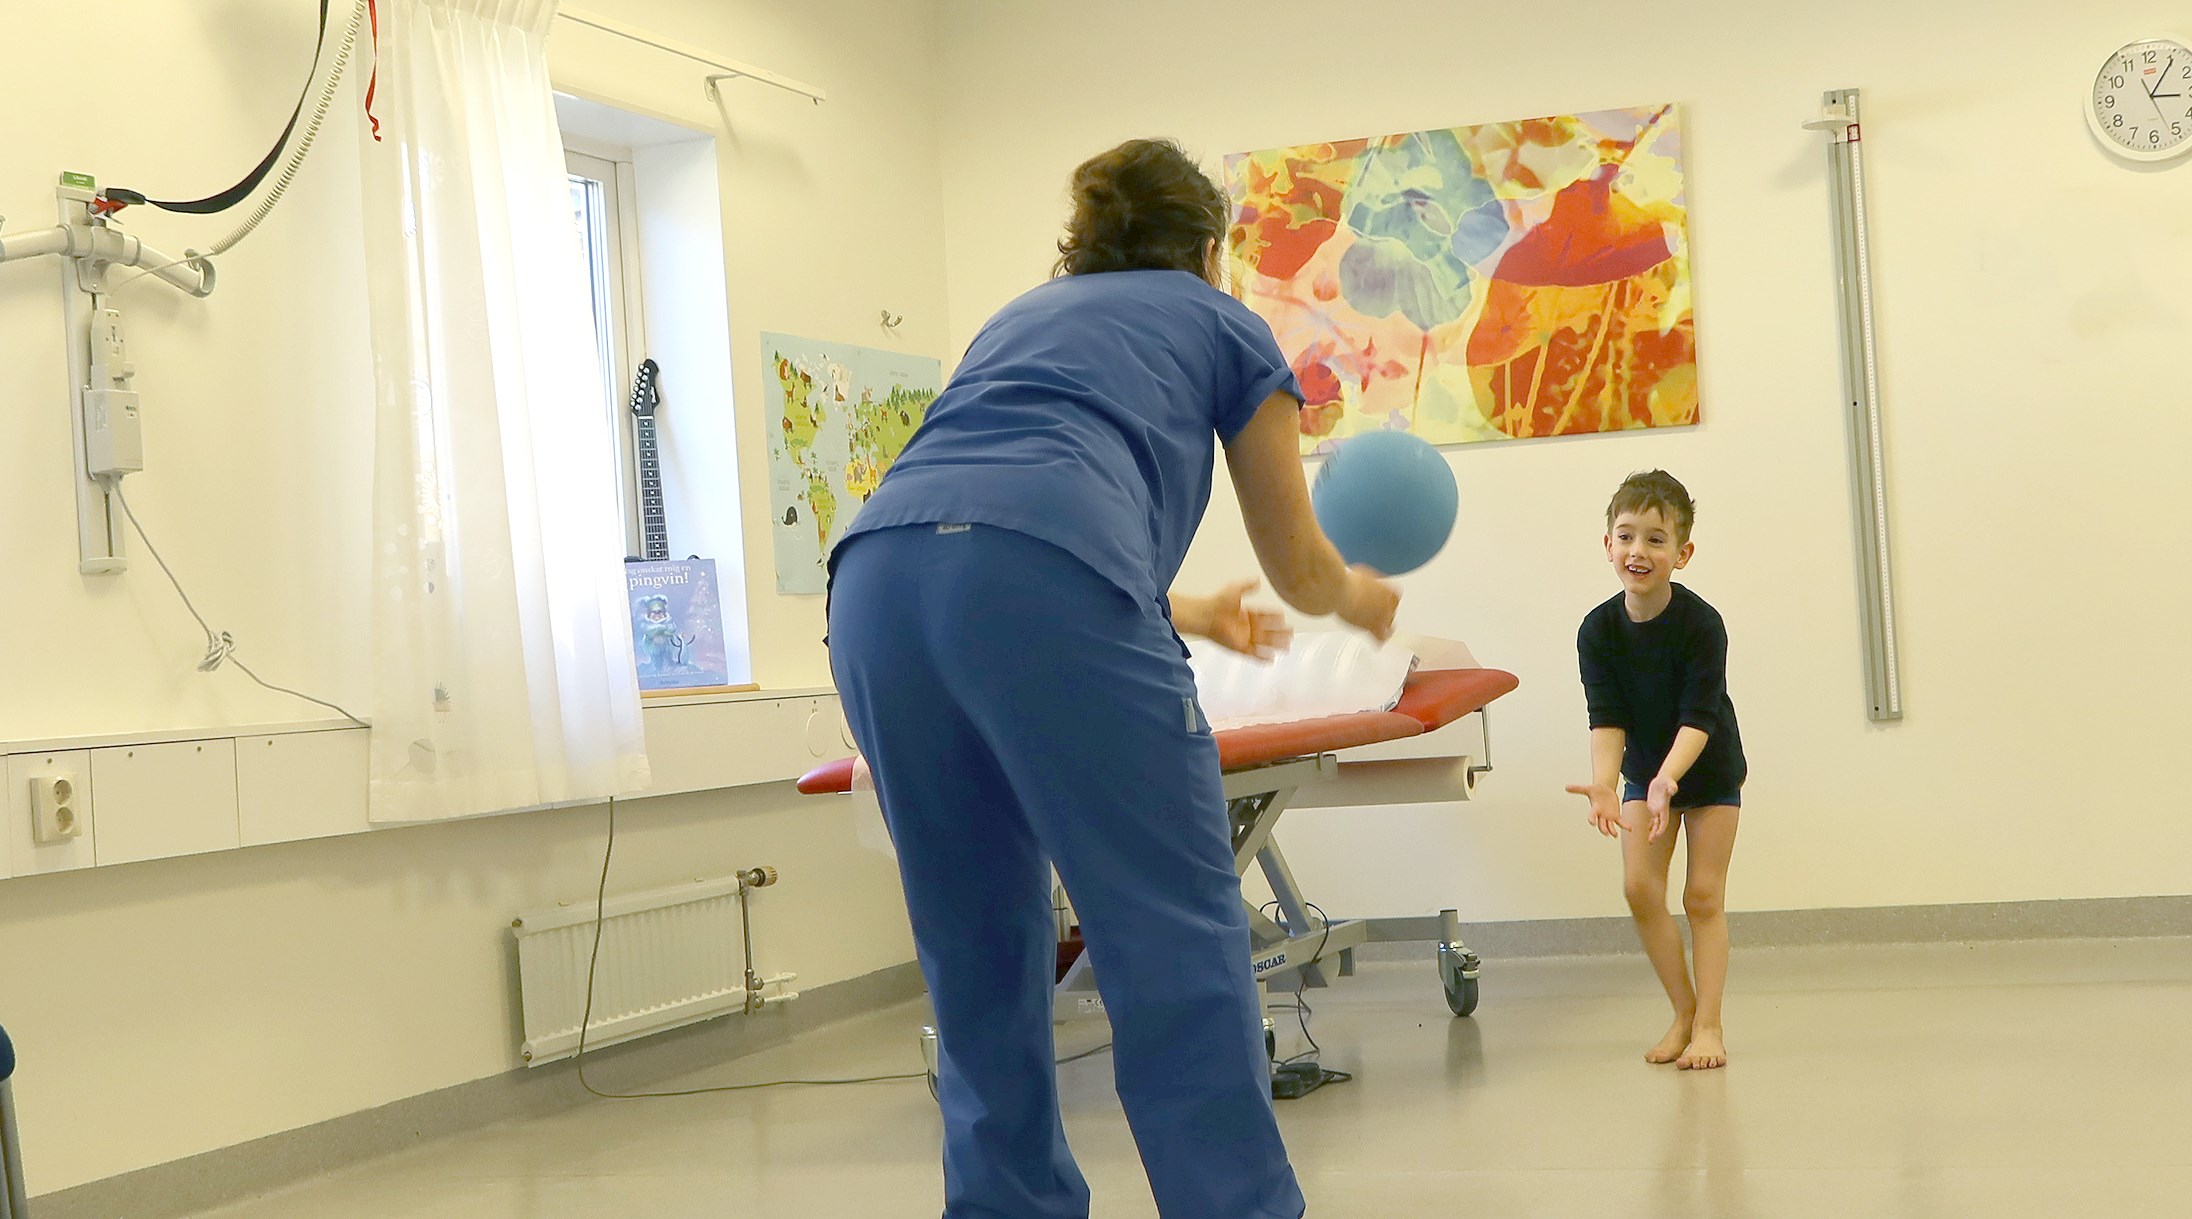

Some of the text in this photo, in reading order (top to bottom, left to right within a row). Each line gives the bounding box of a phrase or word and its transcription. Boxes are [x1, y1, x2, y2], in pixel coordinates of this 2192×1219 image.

[2142, 50, 2157, 64] 12
[2167, 54, 2174, 67] 1
[2122, 59, 2134, 72] 11
[2182, 66, 2191, 79] 2
[2108, 75, 2125, 89] 10
[2105, 95, 2115, 108] 9
[2185, 106, 2192, 119] 4
[2113, 114, 2123, 127] 8
[2129, 126, 2139, 140] 7
[2171, 121, 2182, 135] 5
[2149, 130, 2160, 144] 6
[629, 571, 689, 591] pingvin!
